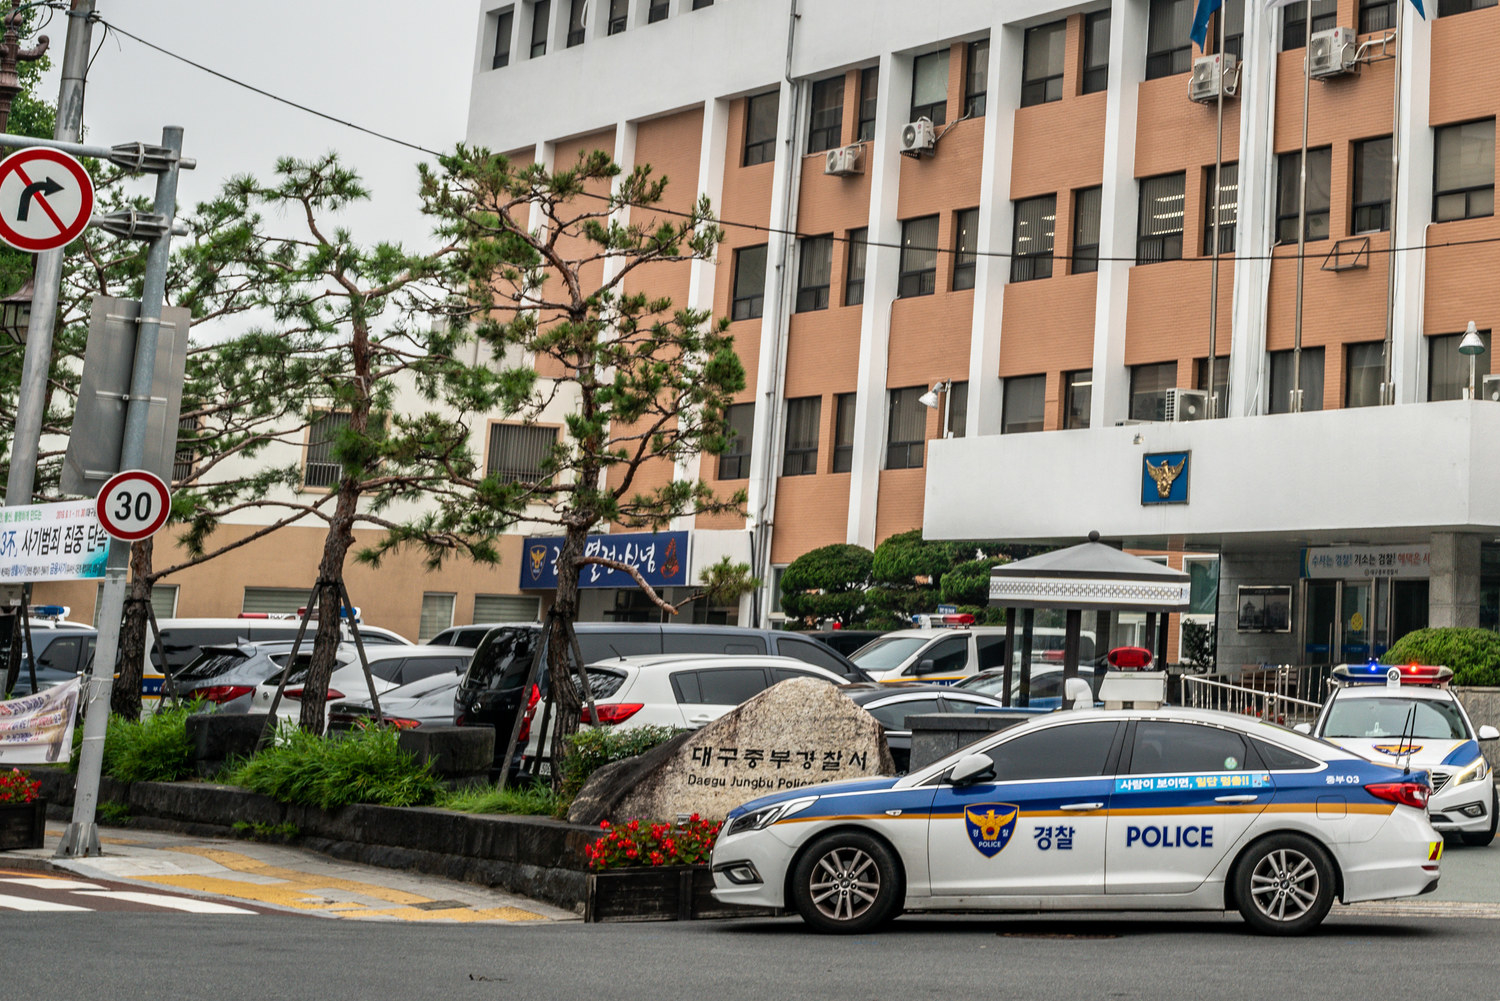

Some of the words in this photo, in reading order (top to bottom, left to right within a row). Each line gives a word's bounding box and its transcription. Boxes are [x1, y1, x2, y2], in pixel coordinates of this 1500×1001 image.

[115, 491, 152, 521] 30
[21, 526, 62, 557] 사기범죄
[64, 525, 84, 554] 집중
[87, 523, 108, 553] 단속
[692, 746, 868, 771] 대구중부경찰서
[688, 774, 726, 787] Daegu
[730, 776, 774, 790] Jungbu
[1120, 778, 1154, 790] 사람이
[1156, 777, 1193, 789] 보이면,
[1195, 776, 1218, 787] 일단
[1346, 775, 1360, 784] 03
[973, 829, 979, 837] 경
[1034, 825, 1075, 850] 경찰
[1126, 825, 1213, 848] POLICE
